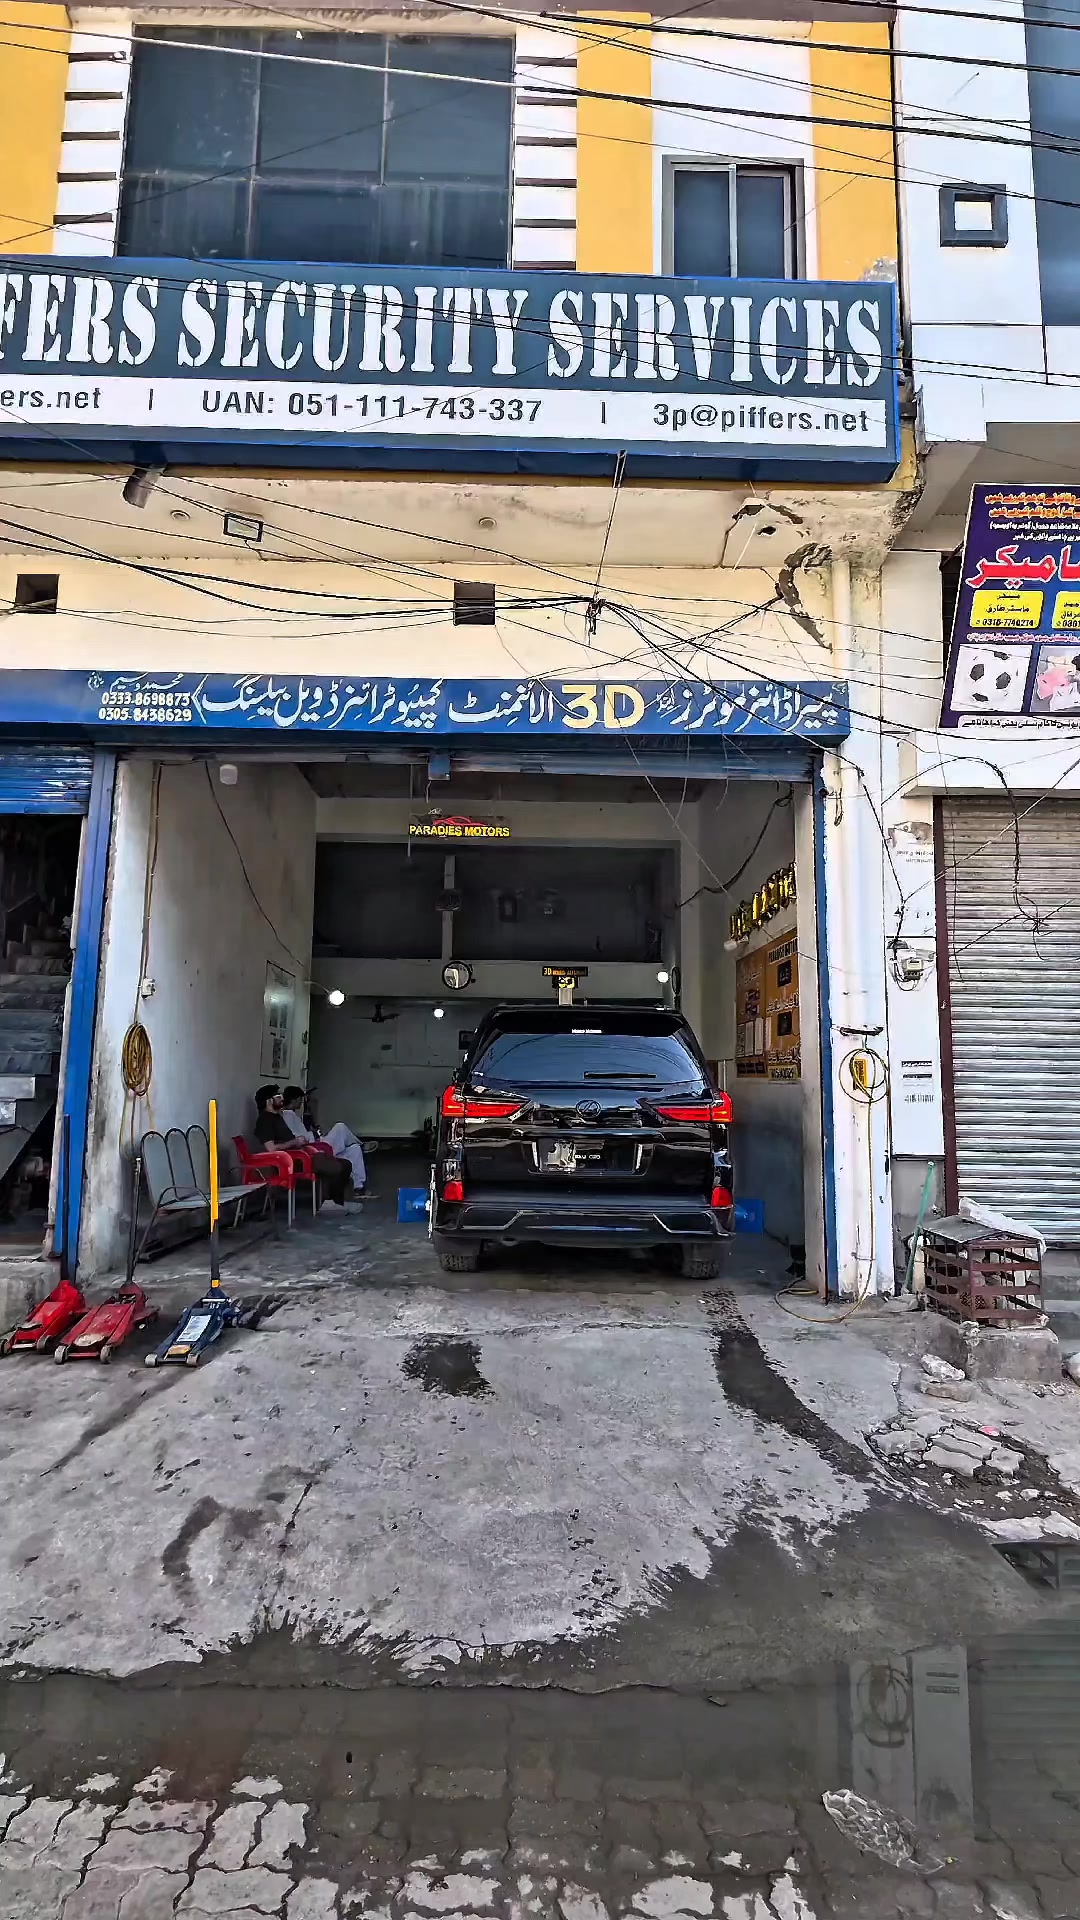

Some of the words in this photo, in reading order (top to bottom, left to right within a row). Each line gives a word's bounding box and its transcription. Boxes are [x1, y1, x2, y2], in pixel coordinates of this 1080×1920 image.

[177, 277, 529, 375] SECURITY
[547, 289, 882, 388] SERVICES
[0, 387, 101, 409] ers.net
[202, 389, 274, 414] UAN:
[287, 391, 543, 422] 051-111-743-337
[653, 402, 869, 432] 3p@piffers.net
[560, 684, 645, 730] 3D
[409, 825, 463, 837] PARADIES
[464, 826, 510, 838] MOTORS
